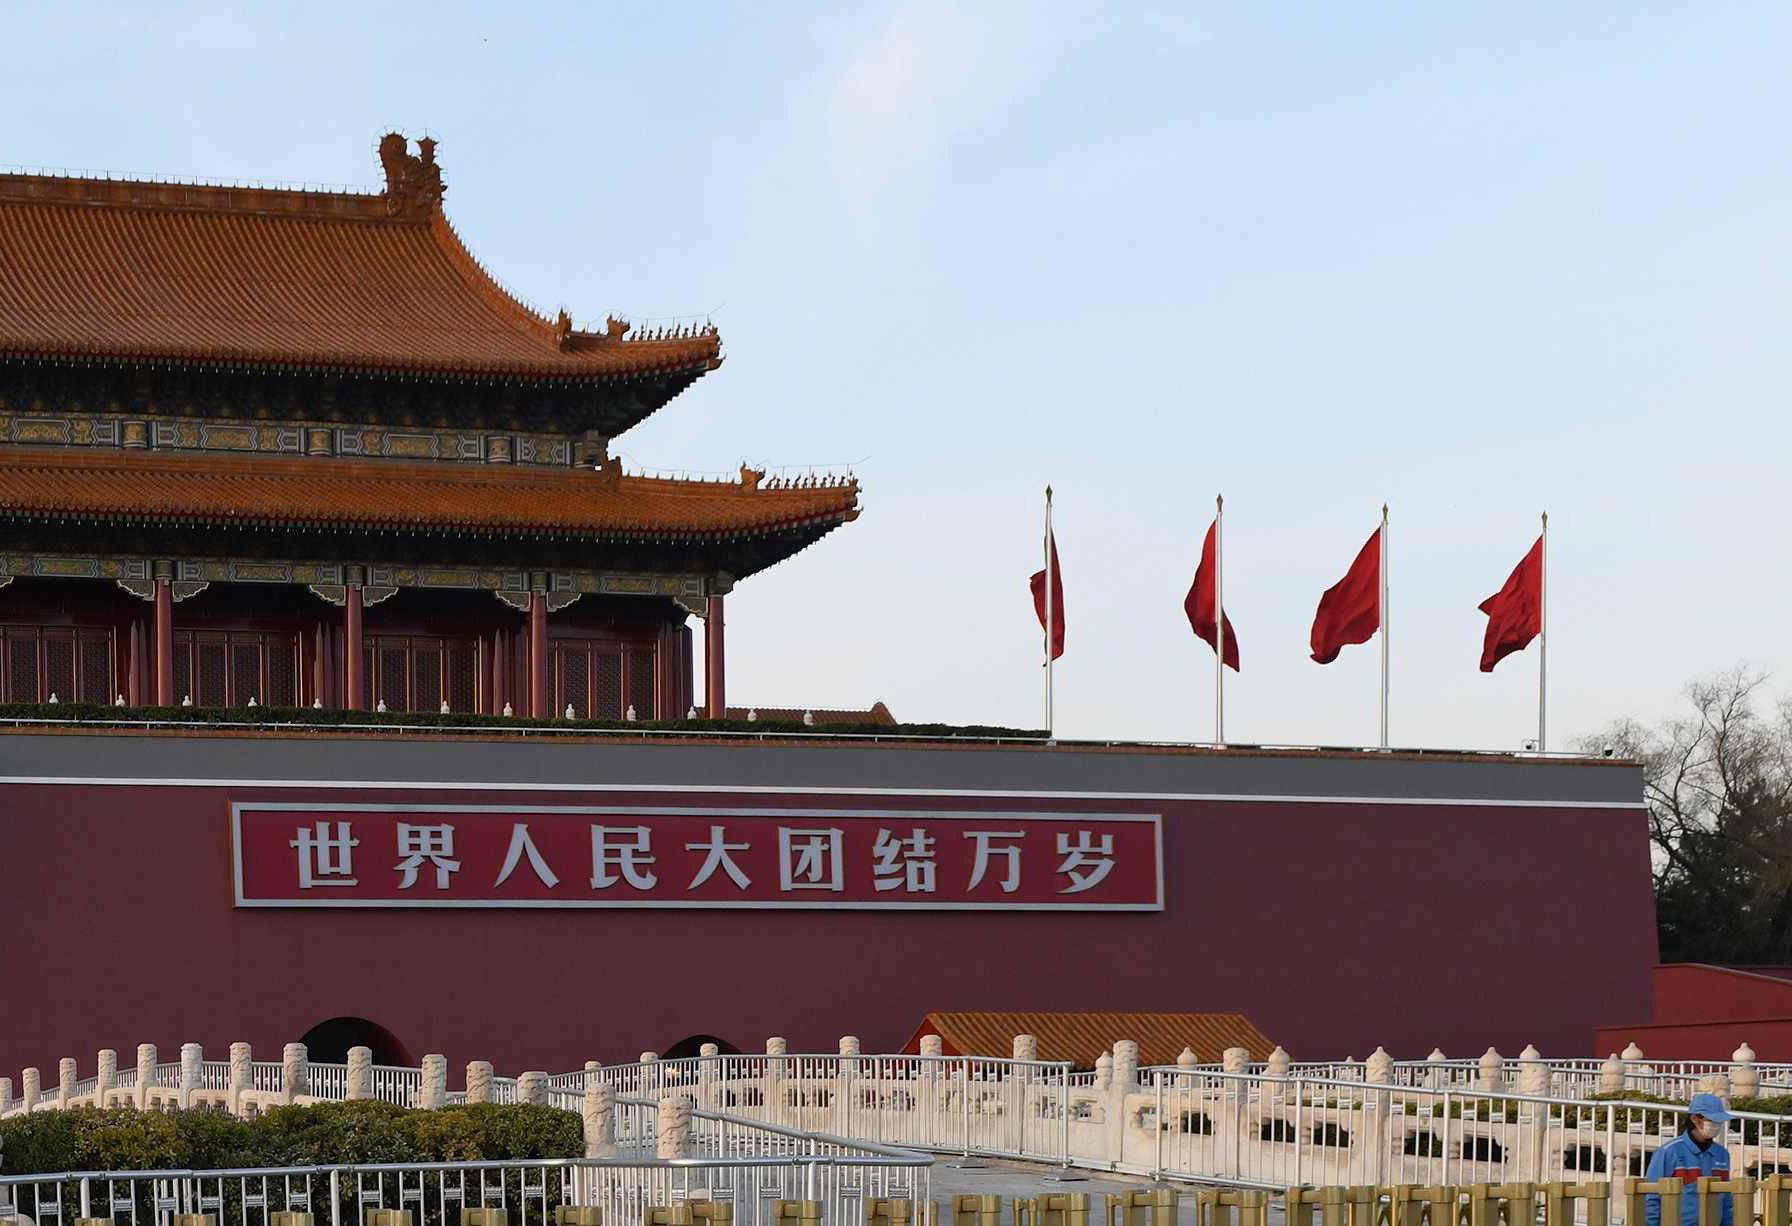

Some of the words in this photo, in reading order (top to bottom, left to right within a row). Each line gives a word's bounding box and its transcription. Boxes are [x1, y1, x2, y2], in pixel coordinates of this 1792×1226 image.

[289, 821, 1116, 894] 世界人民大团结万岁
